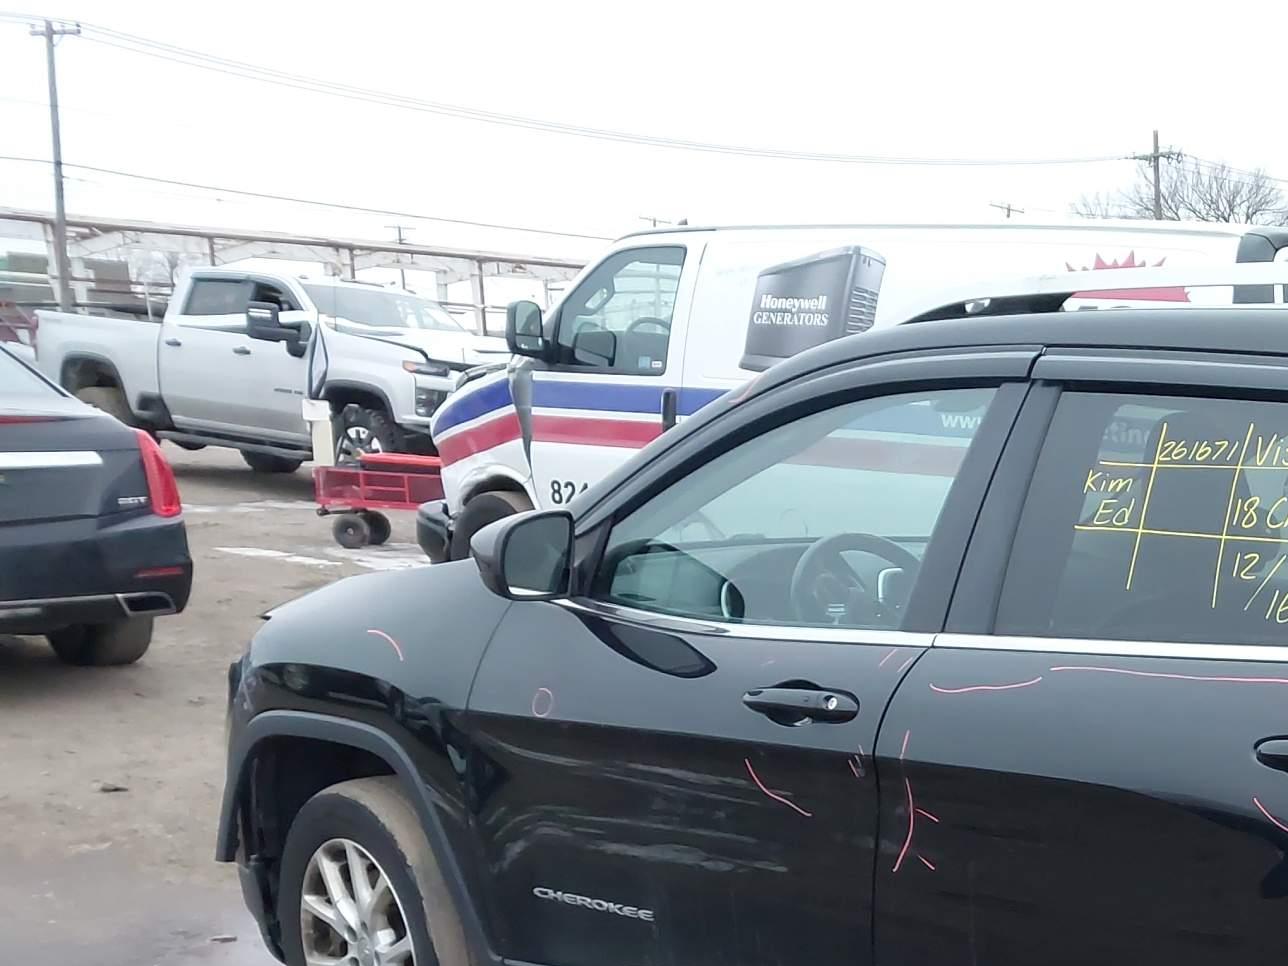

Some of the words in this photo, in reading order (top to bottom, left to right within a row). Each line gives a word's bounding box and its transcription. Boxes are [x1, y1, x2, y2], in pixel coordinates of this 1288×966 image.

[760, 294, 827, 312] Honeywell
[753, 312, 829, 326] GENERATORS
[1159, 440, 1239, 461] 261671
[1083, 469, 1133, 493] Kim
[1093, 498, 1135, 525] Ed
[1233, 496, 1260, 529] 18
[533, 887, 655, 922] CHEROKEE
